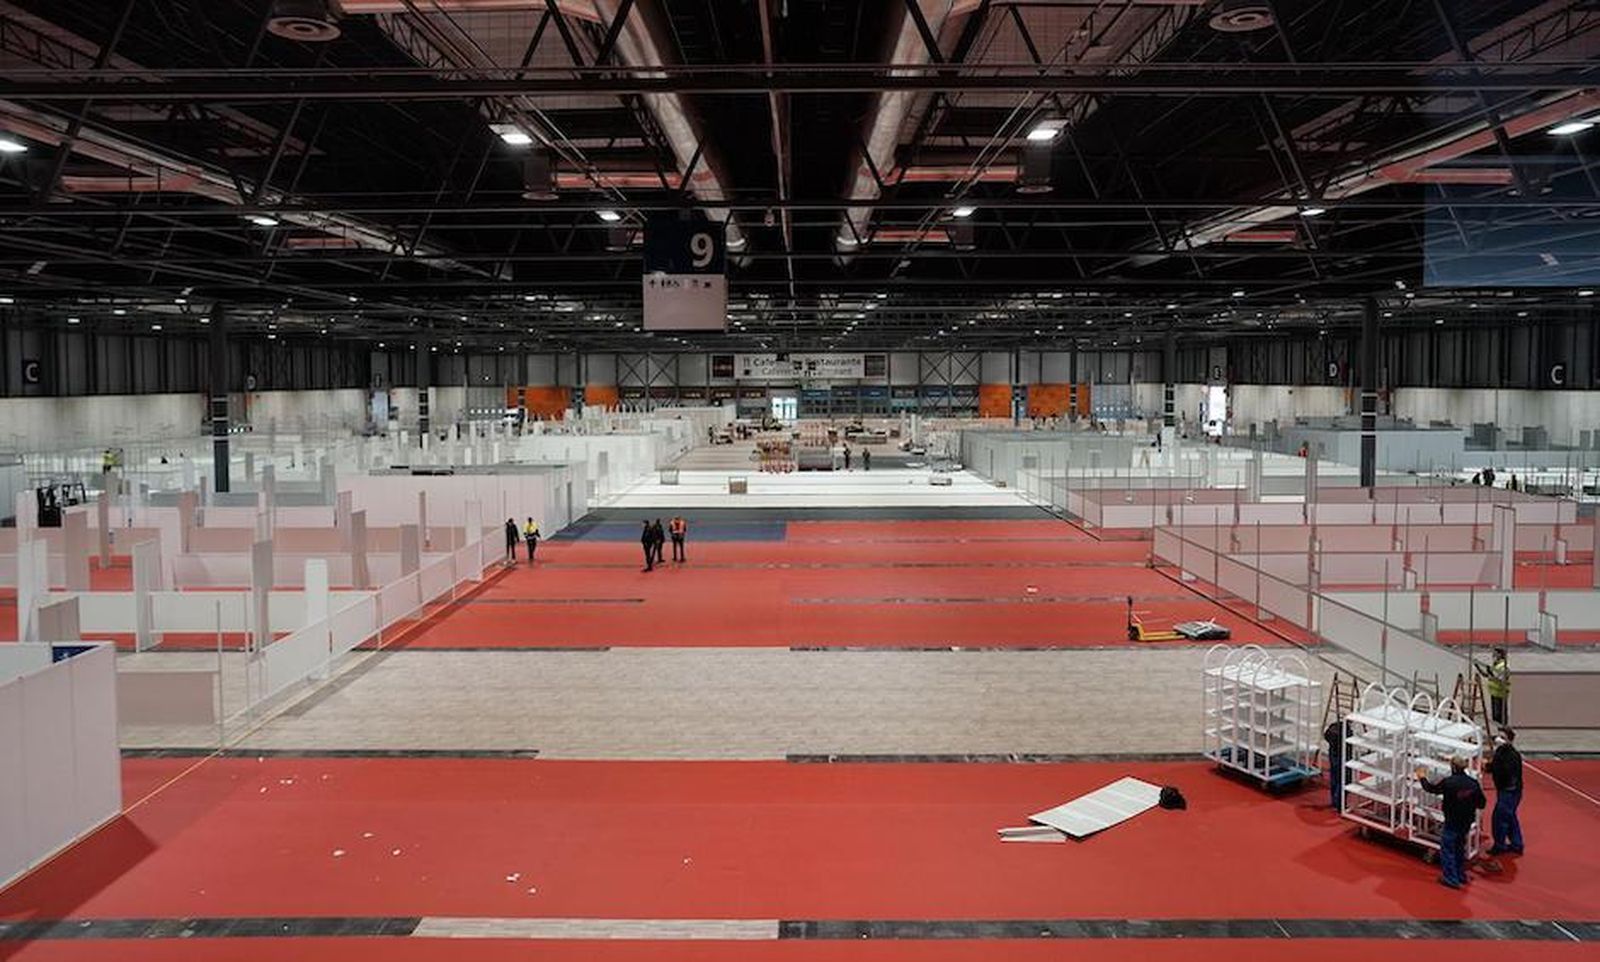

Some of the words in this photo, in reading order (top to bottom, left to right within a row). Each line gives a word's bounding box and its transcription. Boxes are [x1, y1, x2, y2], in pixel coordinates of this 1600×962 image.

[690, 233, 714, 268] 9
[25, 363, 38, 381] C
[1329, 363, 1338, 378] D
[1551, 365, 1563, 384] C
